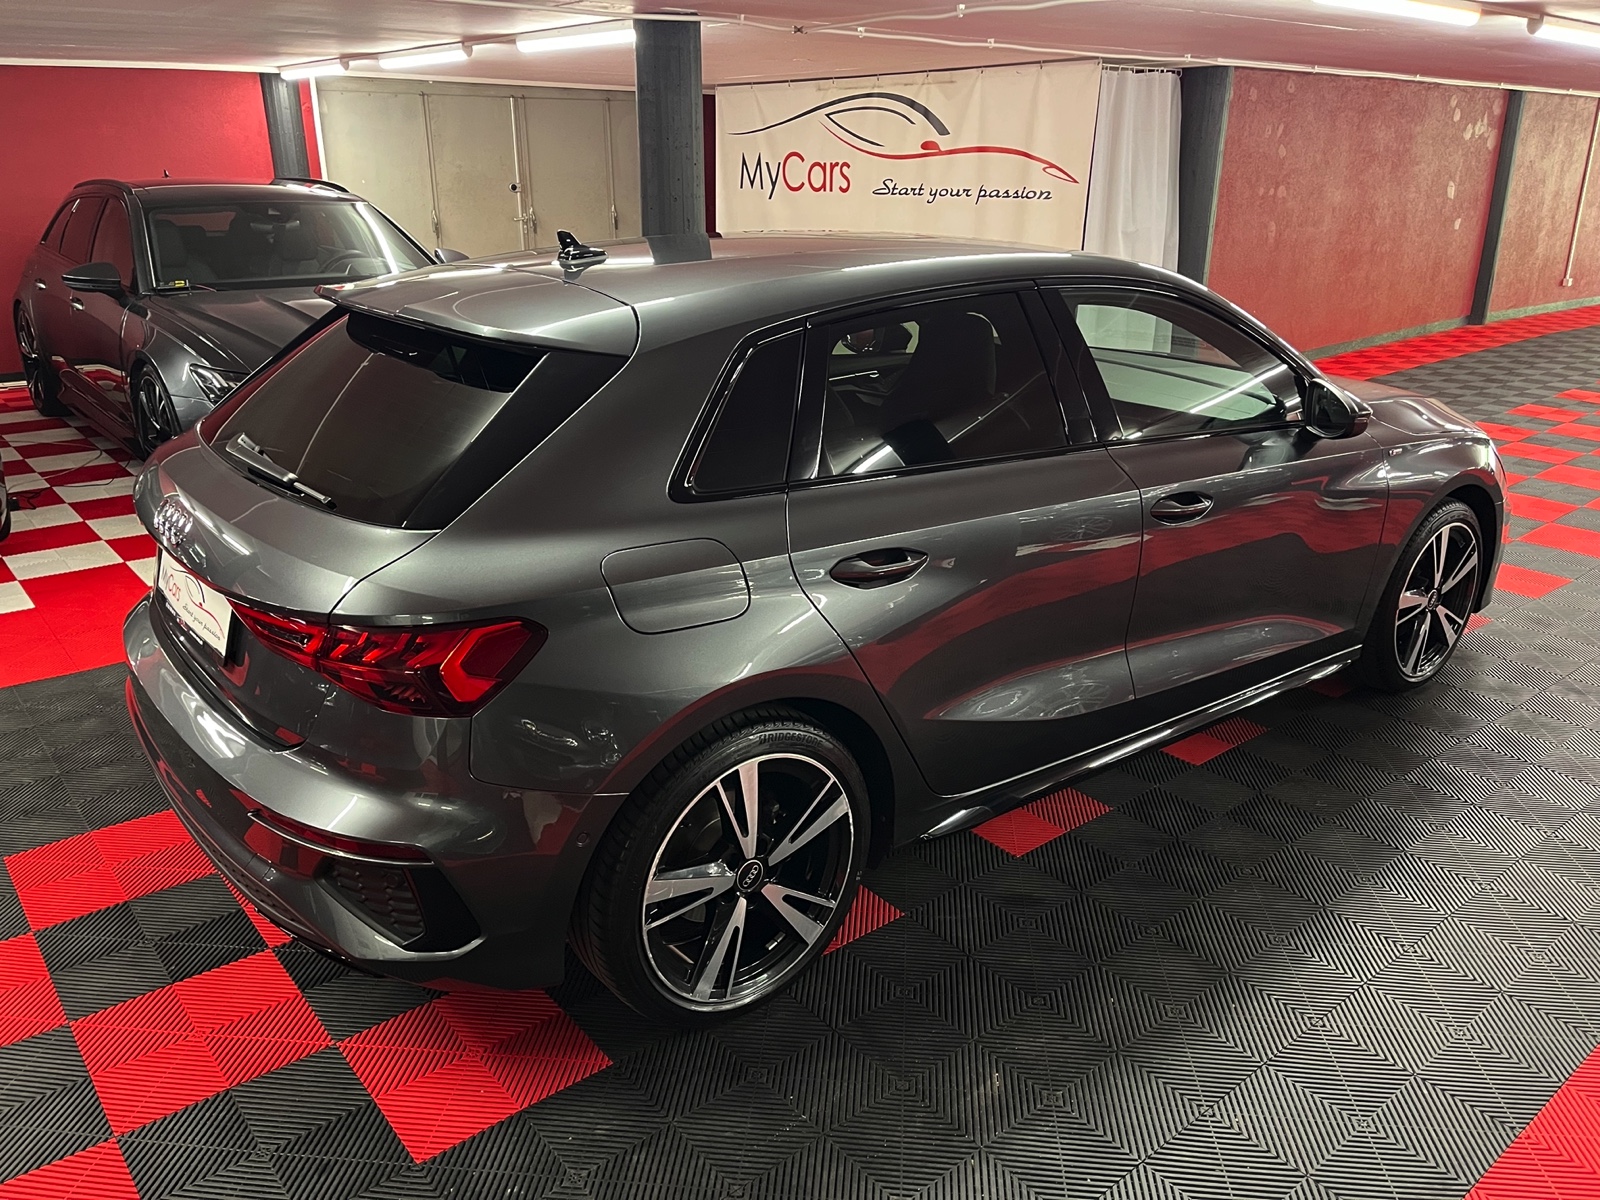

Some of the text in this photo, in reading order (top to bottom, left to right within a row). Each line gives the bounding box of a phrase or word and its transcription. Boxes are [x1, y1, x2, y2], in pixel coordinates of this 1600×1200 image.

[740, 151, 851, 200] MyCars
[872, 178, 1053, 205] Start your passion
[161, 566, 181, 602] MyCars
[758, 732, 824, 748] BRIDGESTONE
